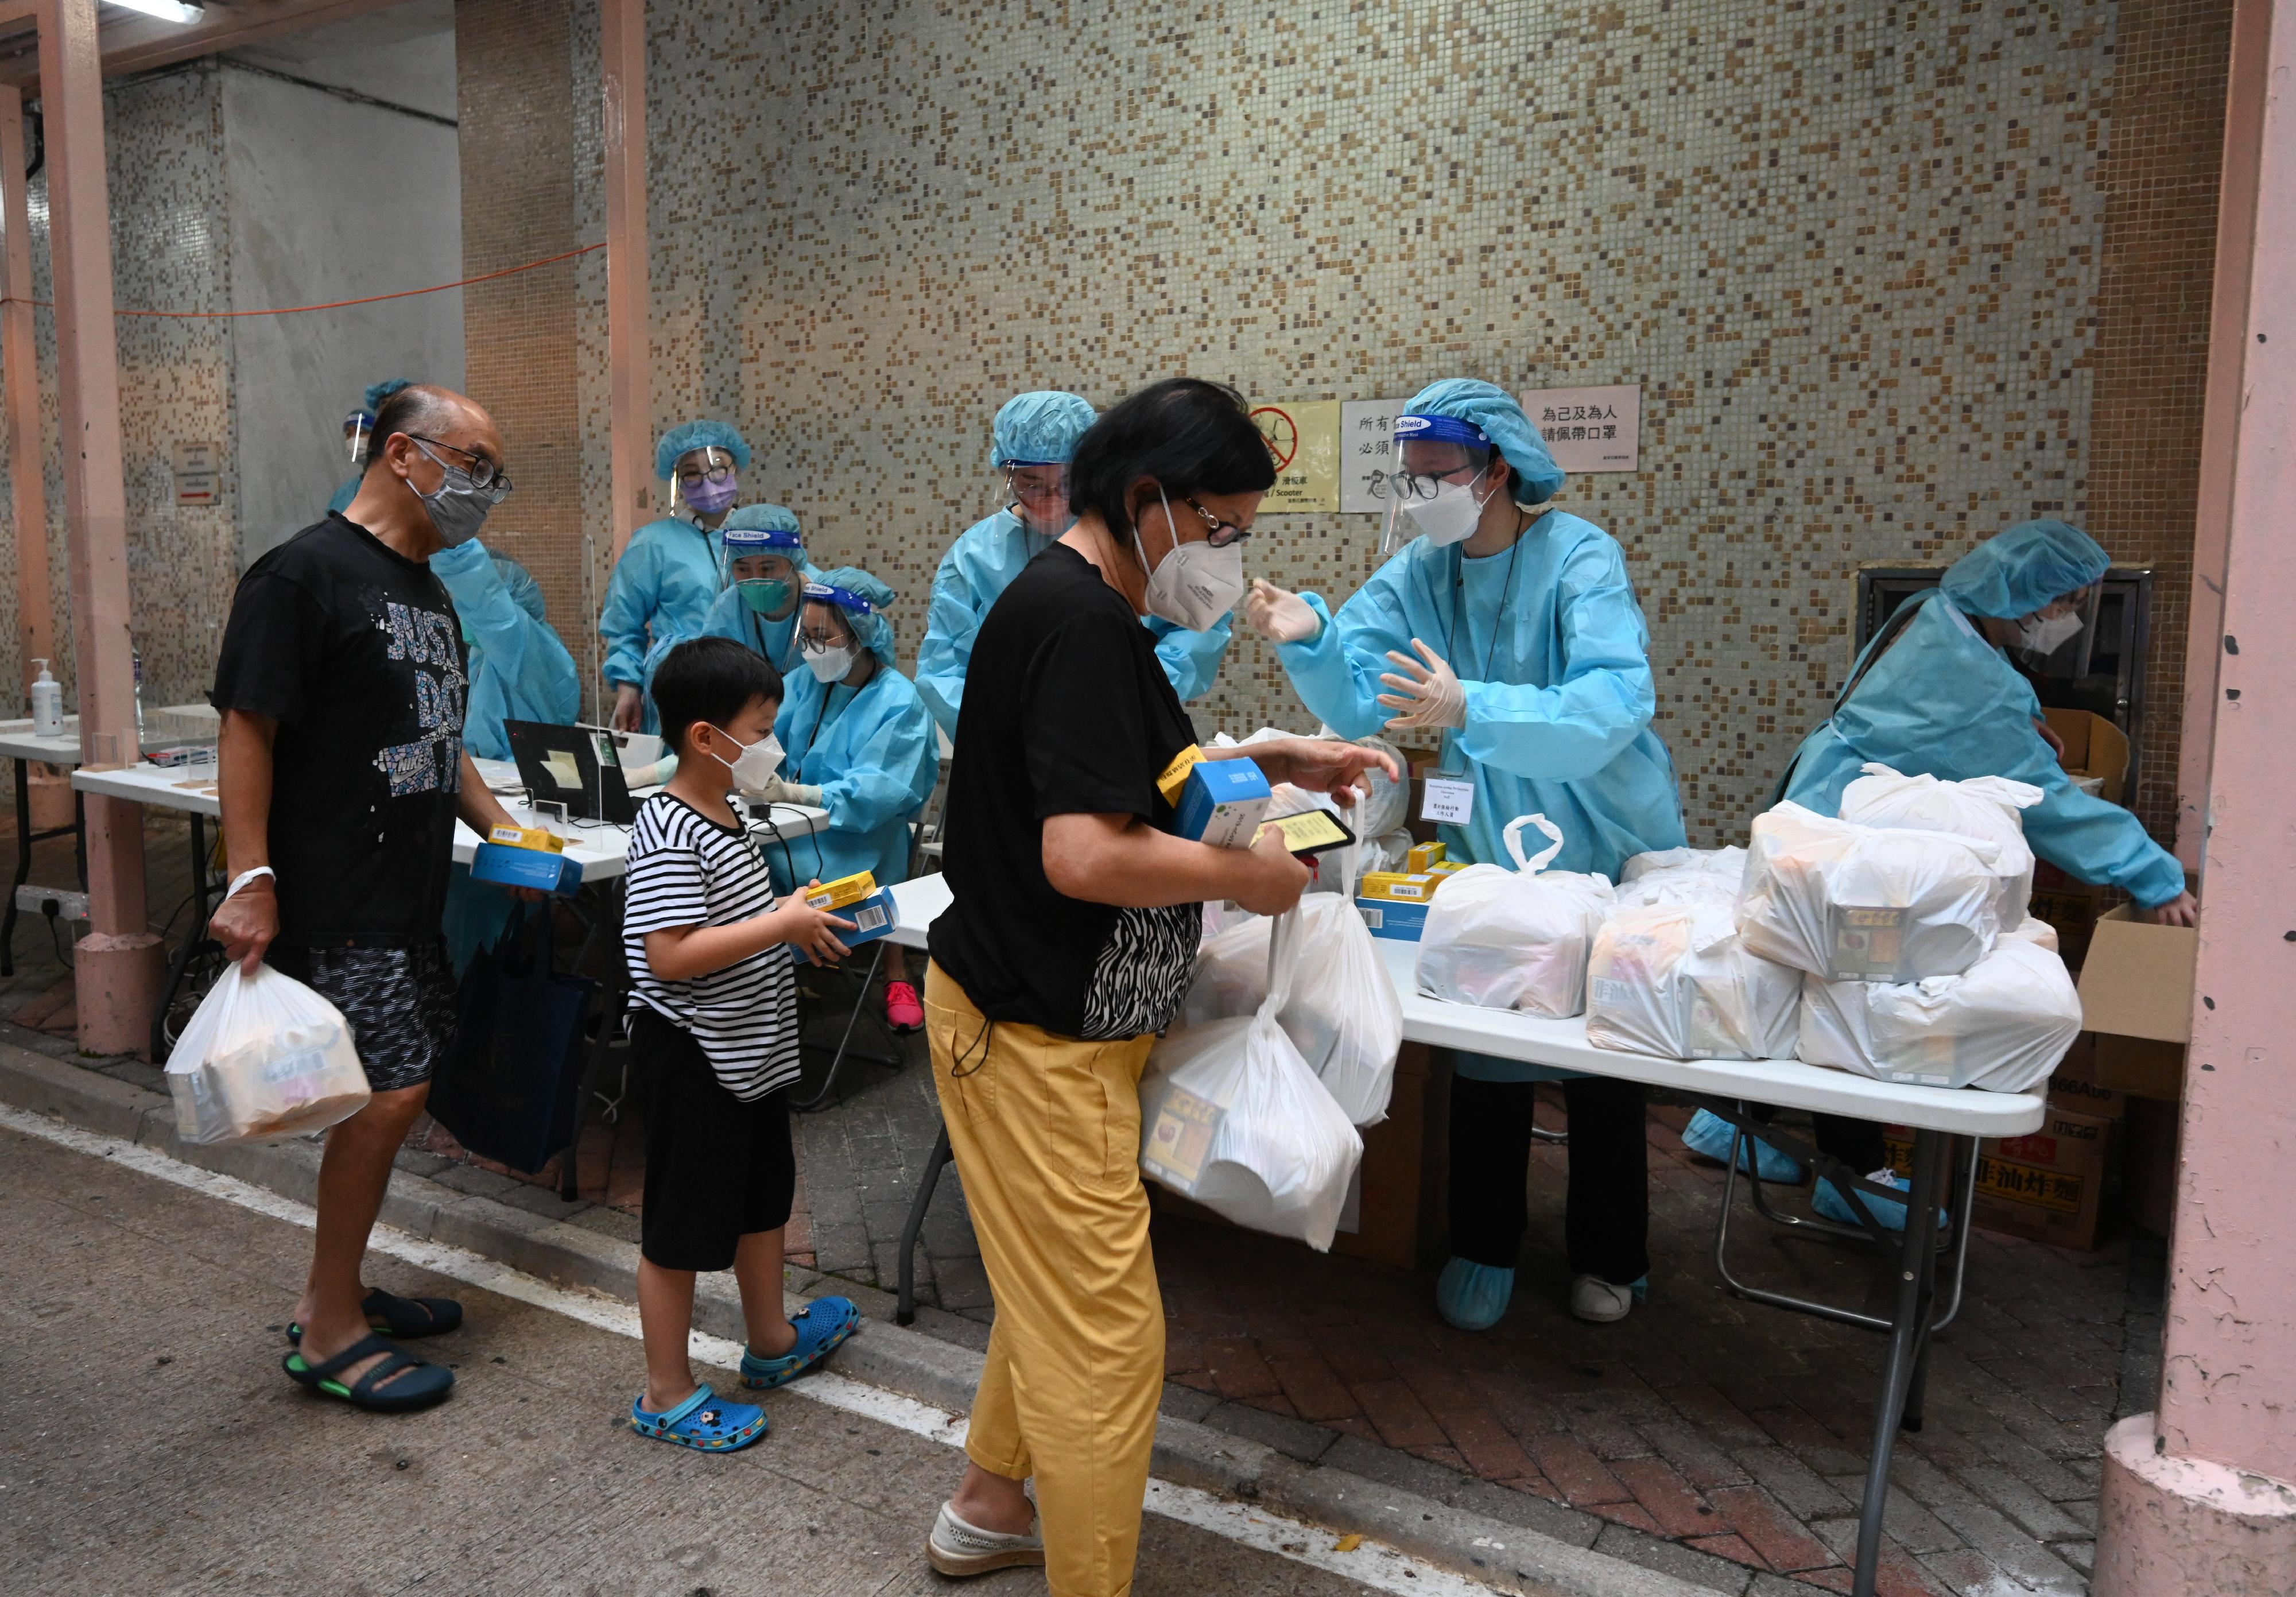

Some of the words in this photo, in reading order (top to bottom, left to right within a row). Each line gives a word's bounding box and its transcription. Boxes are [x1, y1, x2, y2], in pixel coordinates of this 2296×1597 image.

[1542, 404, 1617, 422] 為己及為人
[1401, 420, 1422, 428] Shield
[1541, 425, 1617, 443] 請佩帶口罩
[1359, 440, 1390, 456] 必須
[386, 602, 460, 666] JUST
[415, 669, 463, 731] DO
[397, 753, 426, 773] NIKE
